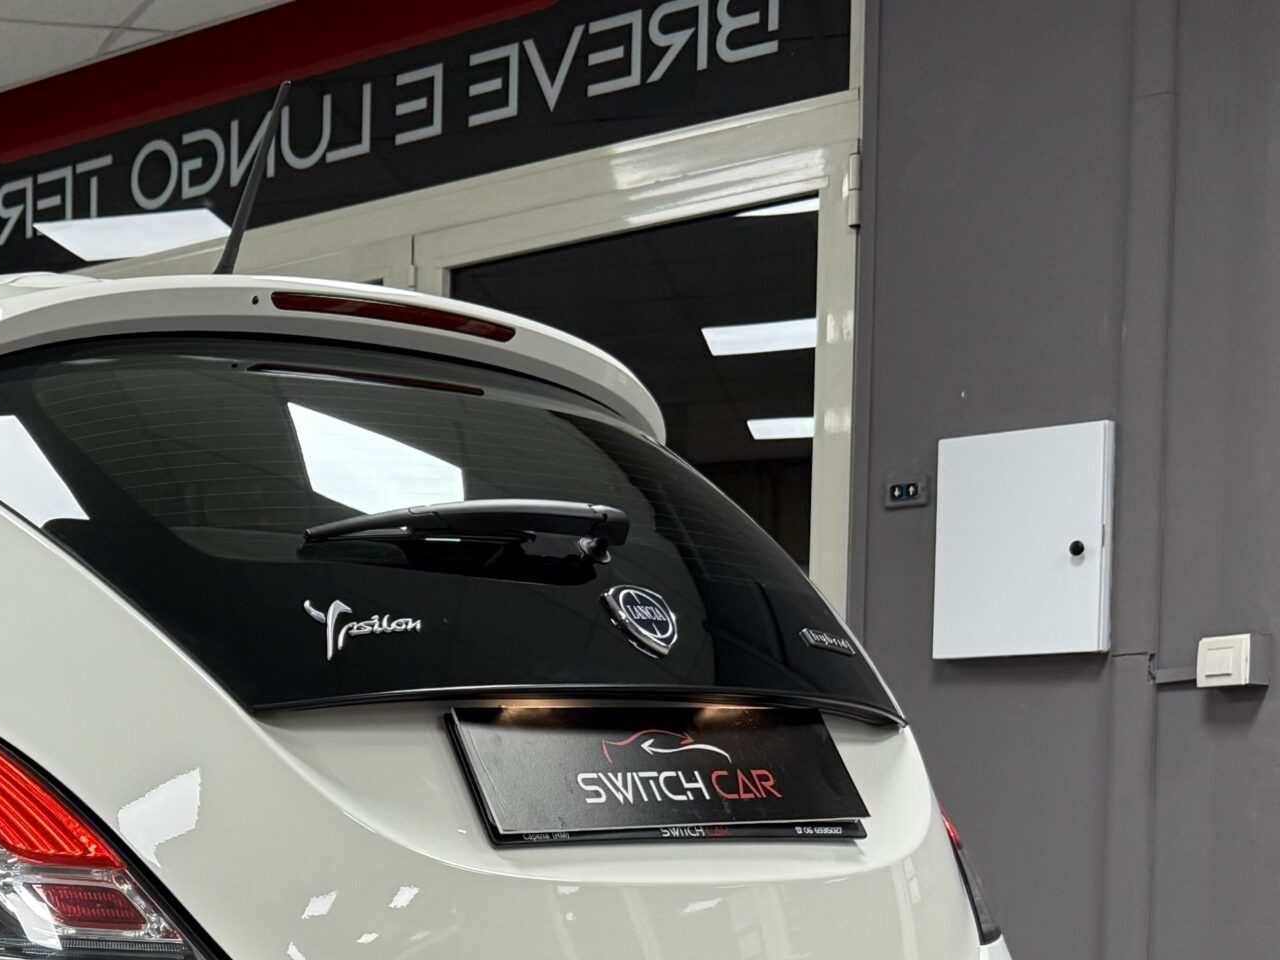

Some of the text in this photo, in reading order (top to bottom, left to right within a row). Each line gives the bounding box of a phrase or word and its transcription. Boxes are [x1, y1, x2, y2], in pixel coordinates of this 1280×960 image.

[303, 599, 422, 661] Ypsilon
[626, 604, 667, 621] LANCIA
[576, 768, 783, 804] SWITCH CAR
